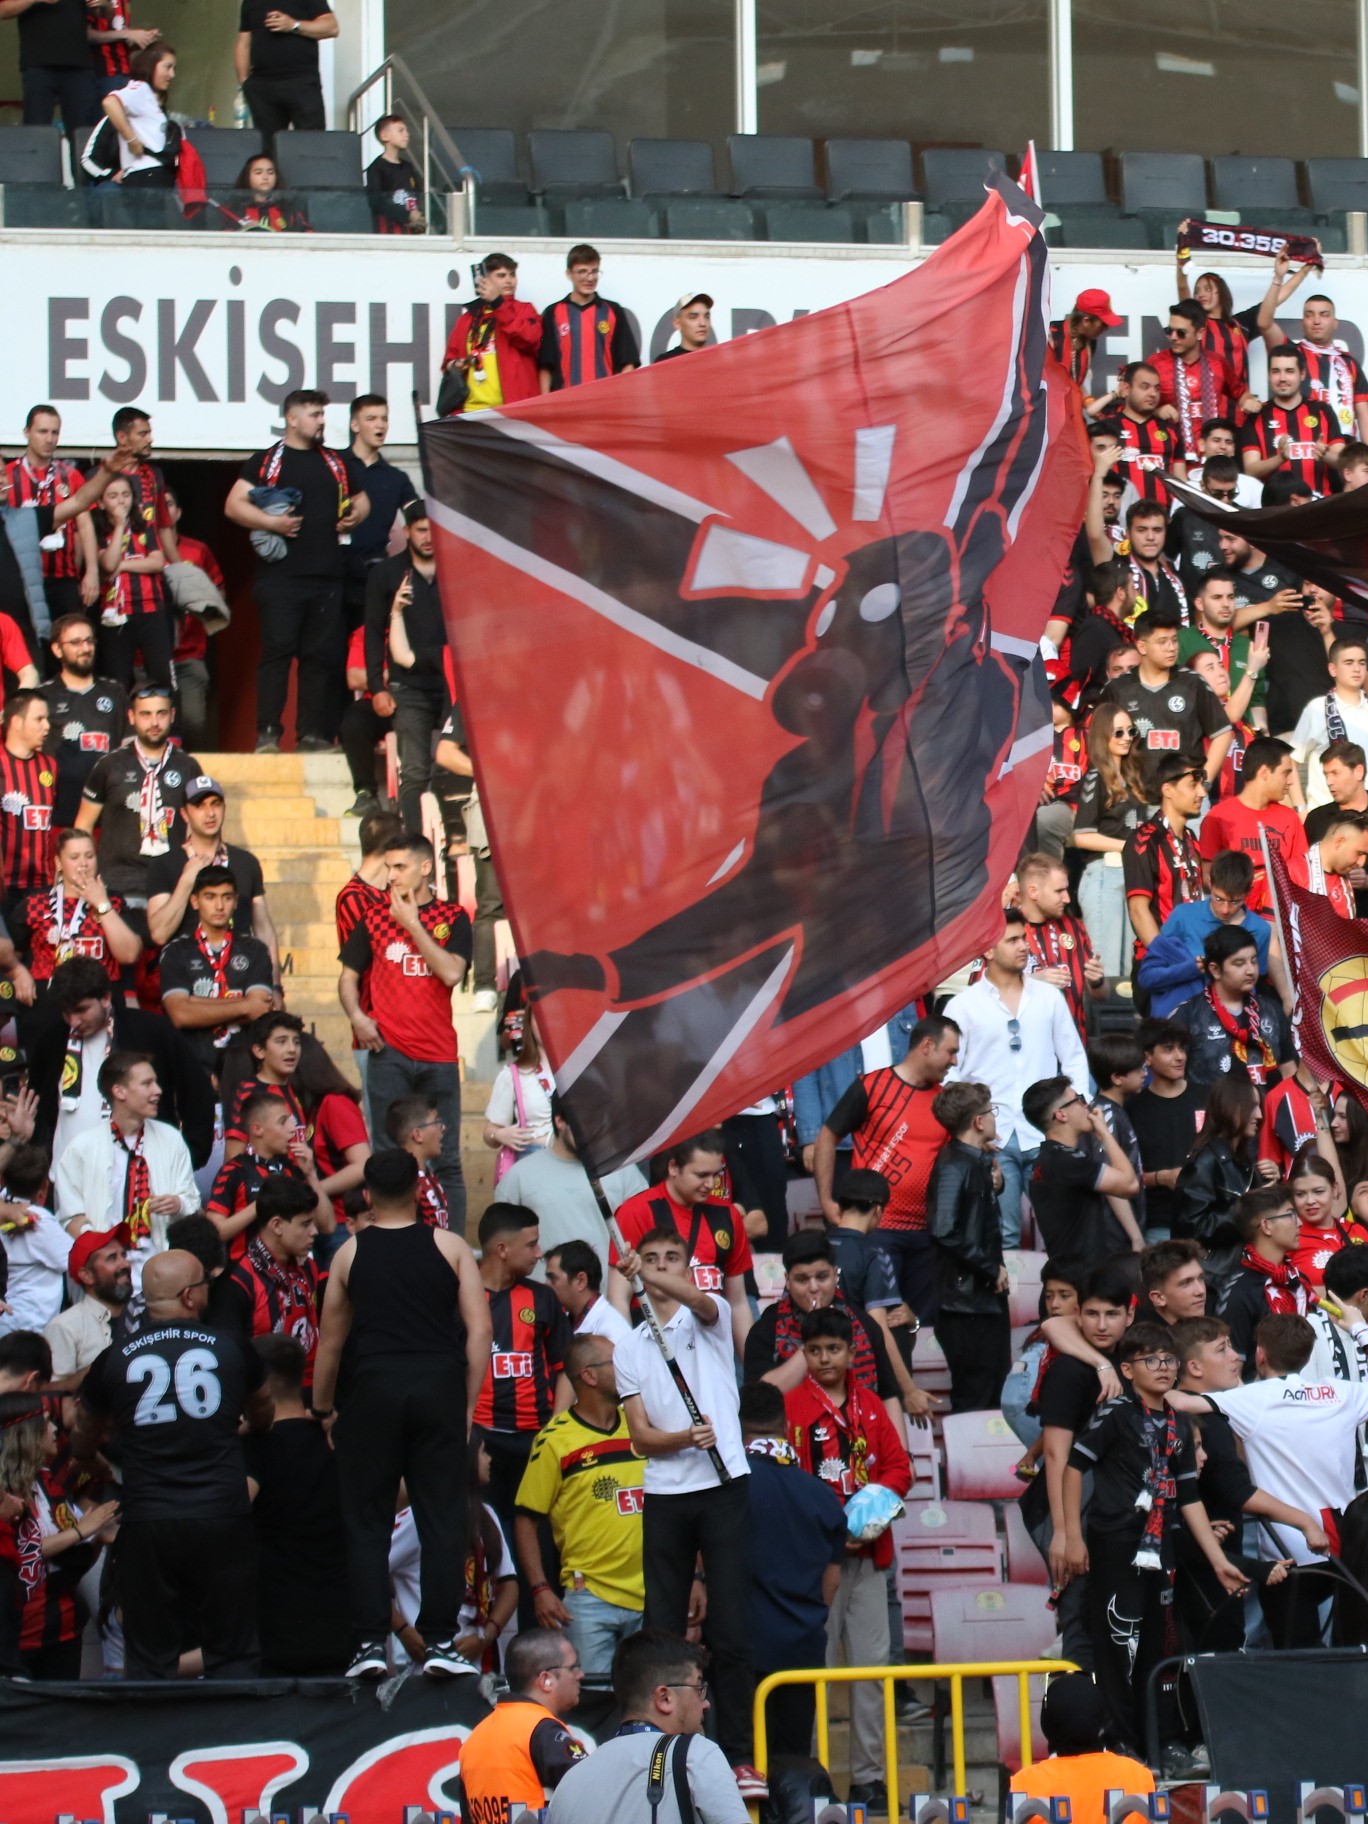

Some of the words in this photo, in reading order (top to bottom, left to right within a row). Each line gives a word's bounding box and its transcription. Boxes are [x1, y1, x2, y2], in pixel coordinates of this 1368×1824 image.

[1240, 838, 1282, 852] PUA
[122, 1328, 181, 1357] ESKİŞEHİR
[183, 1330, 216, 1346] SPOR
[126, 1348, 222, 1426] 26
[615, 1487, 644, 1515] ET
[652, 1752, 663, 1780] Nikon
